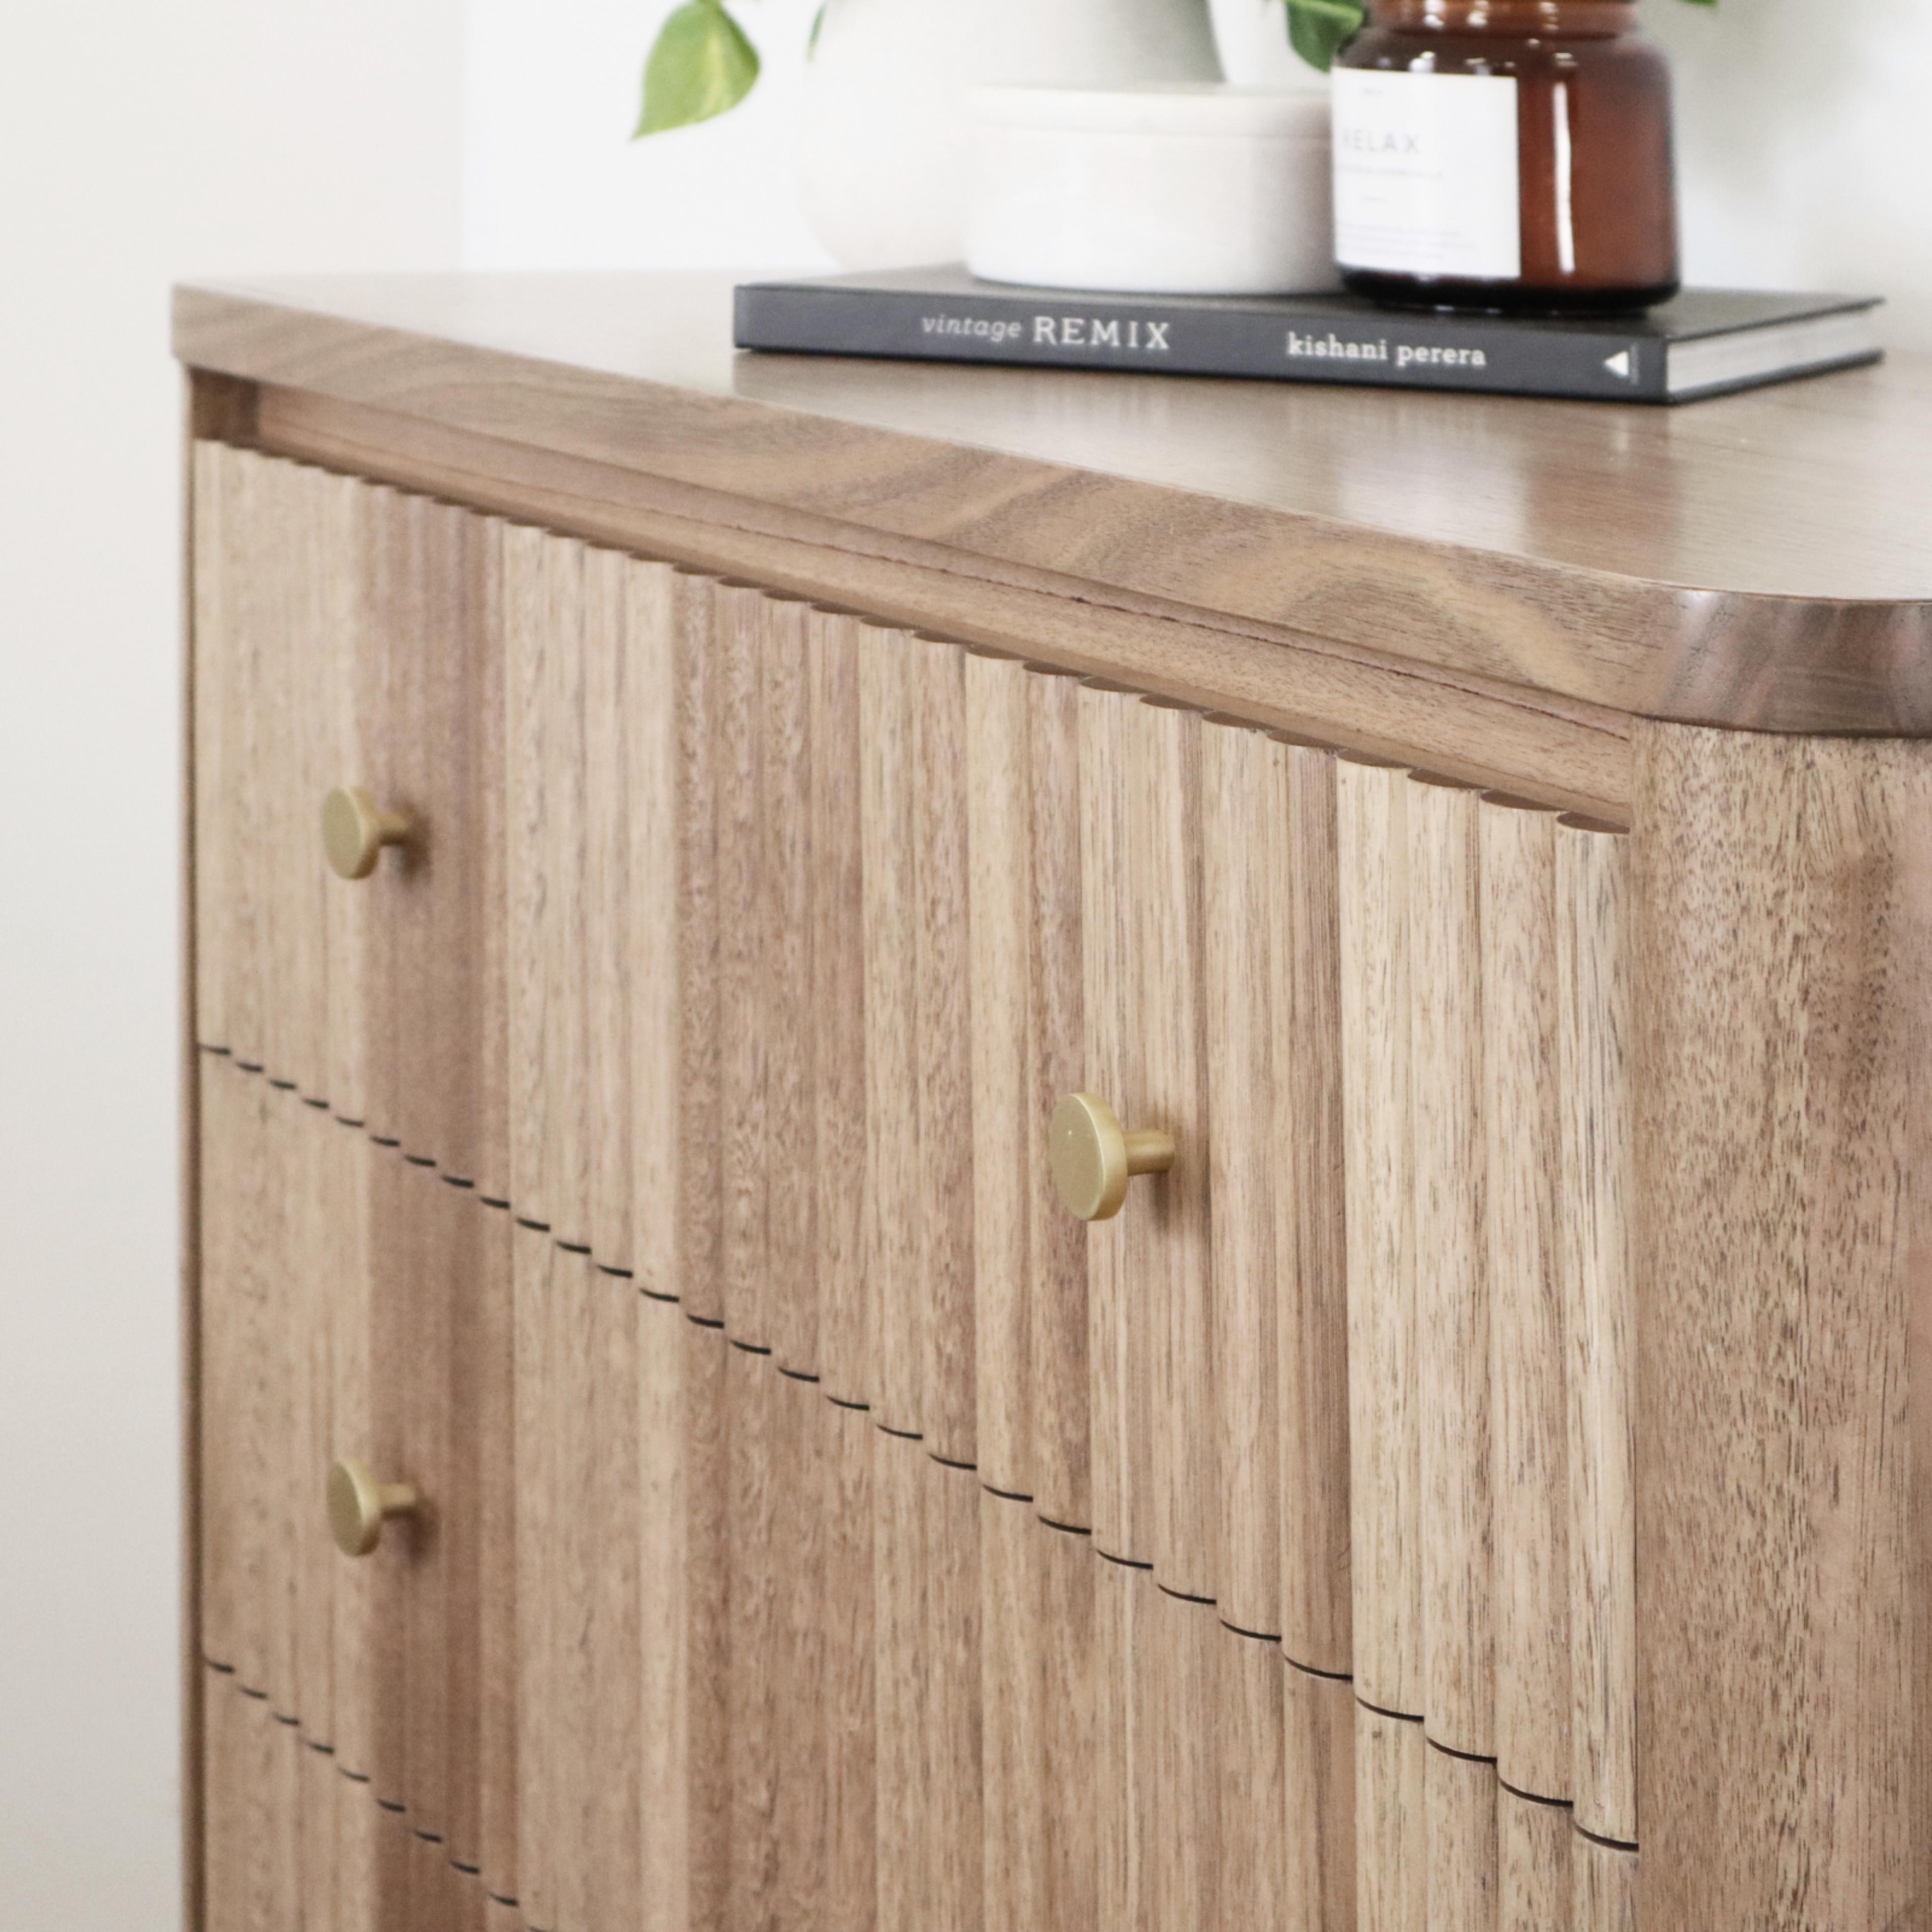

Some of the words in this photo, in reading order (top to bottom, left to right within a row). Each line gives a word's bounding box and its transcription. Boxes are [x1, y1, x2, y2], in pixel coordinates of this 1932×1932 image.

[922, 314, 1021, 343] vintage
[1033, 315, 1170, 350] REMIX
[1287, 331, 1388, 360] kishani
[1396, 343, 1486, 367] perera
